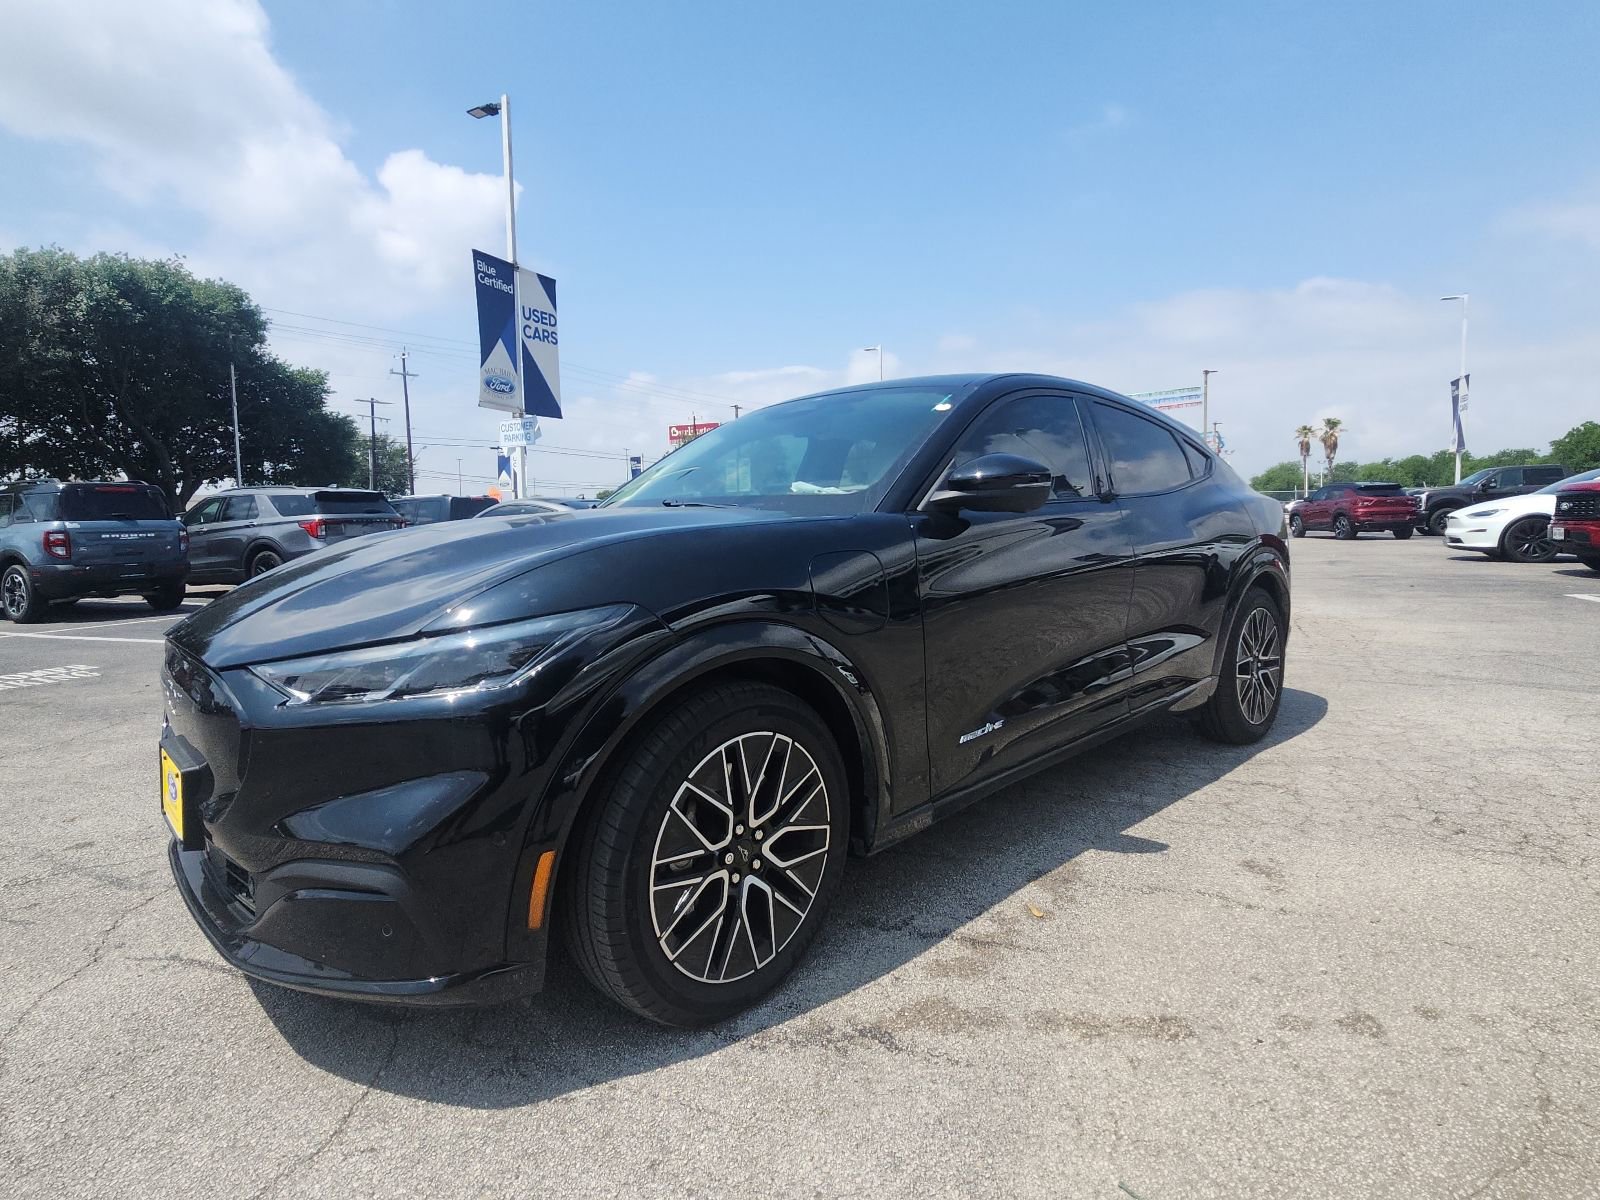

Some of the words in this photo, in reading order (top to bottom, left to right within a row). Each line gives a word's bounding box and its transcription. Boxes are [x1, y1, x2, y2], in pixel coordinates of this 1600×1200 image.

[477, 260, 496, 276] Blue
[478, 273, 513, 294] Certified
[522, 305, 557, 327] USED
[523, 324, 558, 345] CARS
[490, 377, 511, 392] Ford
[501, 421, 534, 432] CUSTOMER
[504, 432, 531, 442] PARKING
